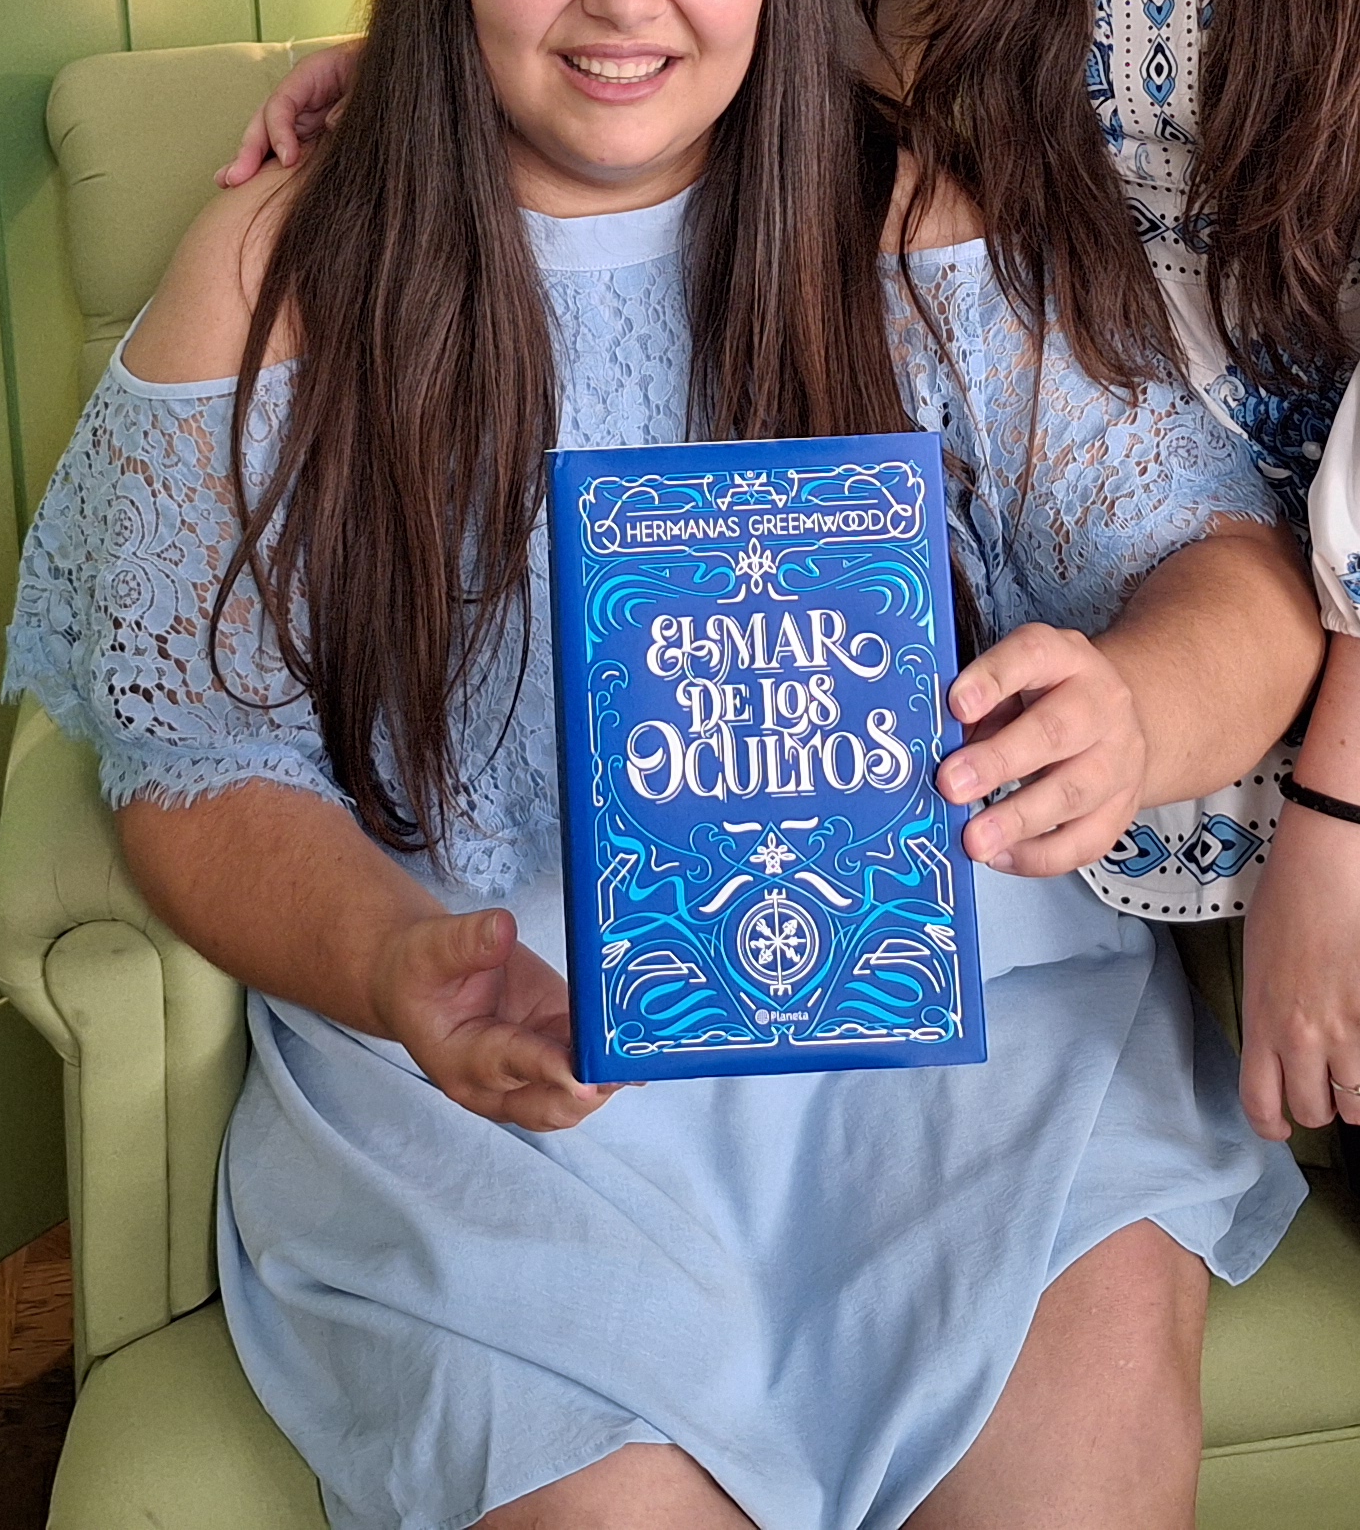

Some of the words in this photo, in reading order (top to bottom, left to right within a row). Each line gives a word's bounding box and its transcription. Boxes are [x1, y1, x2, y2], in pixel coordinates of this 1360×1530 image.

[626, 517, 740, 543] HERMANAS
[748, 509, 885, 536] GREEMWOOD
[647, 614, 720, 681] EL
[705, 609, 891, 682] MAR
[676, 677, 753, 738] DE
[756, 673, 841, 736] LOS
[626, 708, 913, 804] OCULTOS
[770, 1010, 809, 1022] Planeta
